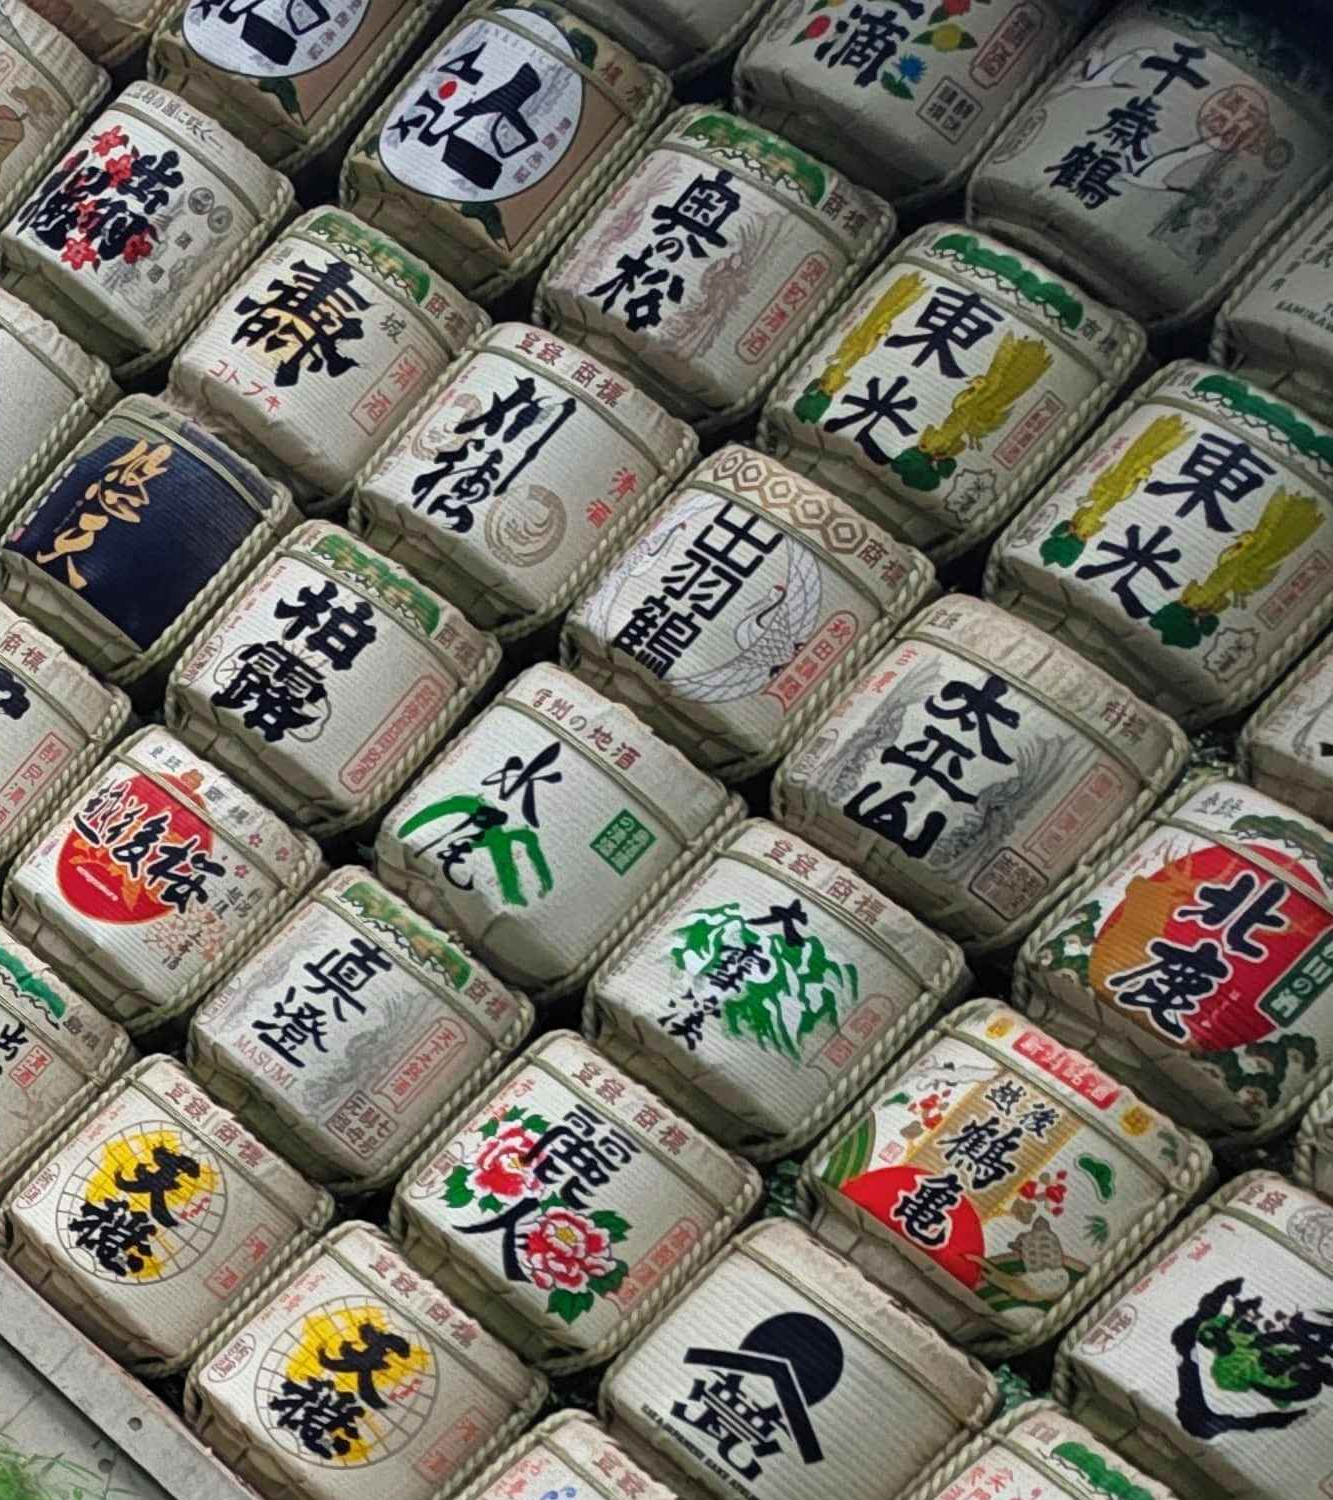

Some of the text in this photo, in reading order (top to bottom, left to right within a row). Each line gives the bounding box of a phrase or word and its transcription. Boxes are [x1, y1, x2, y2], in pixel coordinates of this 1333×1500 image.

[1046, 39, 1209, 212] 千歳鶴
[588, 169, 740, 333] 奥の松
[204, 360, 281, 425] コトブキ
[362, 357, 427, 431] 清酒
[571, 361, 628, 408] 商標
[823, 287, 1003, 478] 東光
[587, 467, 637, 528] 清酒
[1076, 434, 1276, 630] 東光
[0, 630, 47, 673] 商標
[608, 500, 784, 682] 出羽鶴
[210, 582, 376, 742] 柏露
[532, 689, 642, 780] 信州の地酒
[845, 672, 1022, 861] 太平山
[75, 792, 225, 913] 越後桜
[413, 742, 561, 891] 水尾
[826, 876, 887, 932] 商標
[1109, 876, 1285, 1041] 北鹿
[253, 939, 391, 1067] 真澄
[658, 900, 808, 1050] 大雪渓
[233, 1035, 299, 1098] MASUMI
[633, 1104, 690, 1156] 商標
[986, 1082, 1054, 1136] 越後
[209, 1121, 264, 1168] 商標
[454, 1105, 640, 1283] 麗人
[895, 1118, 1022, 1245] 鶴亀
